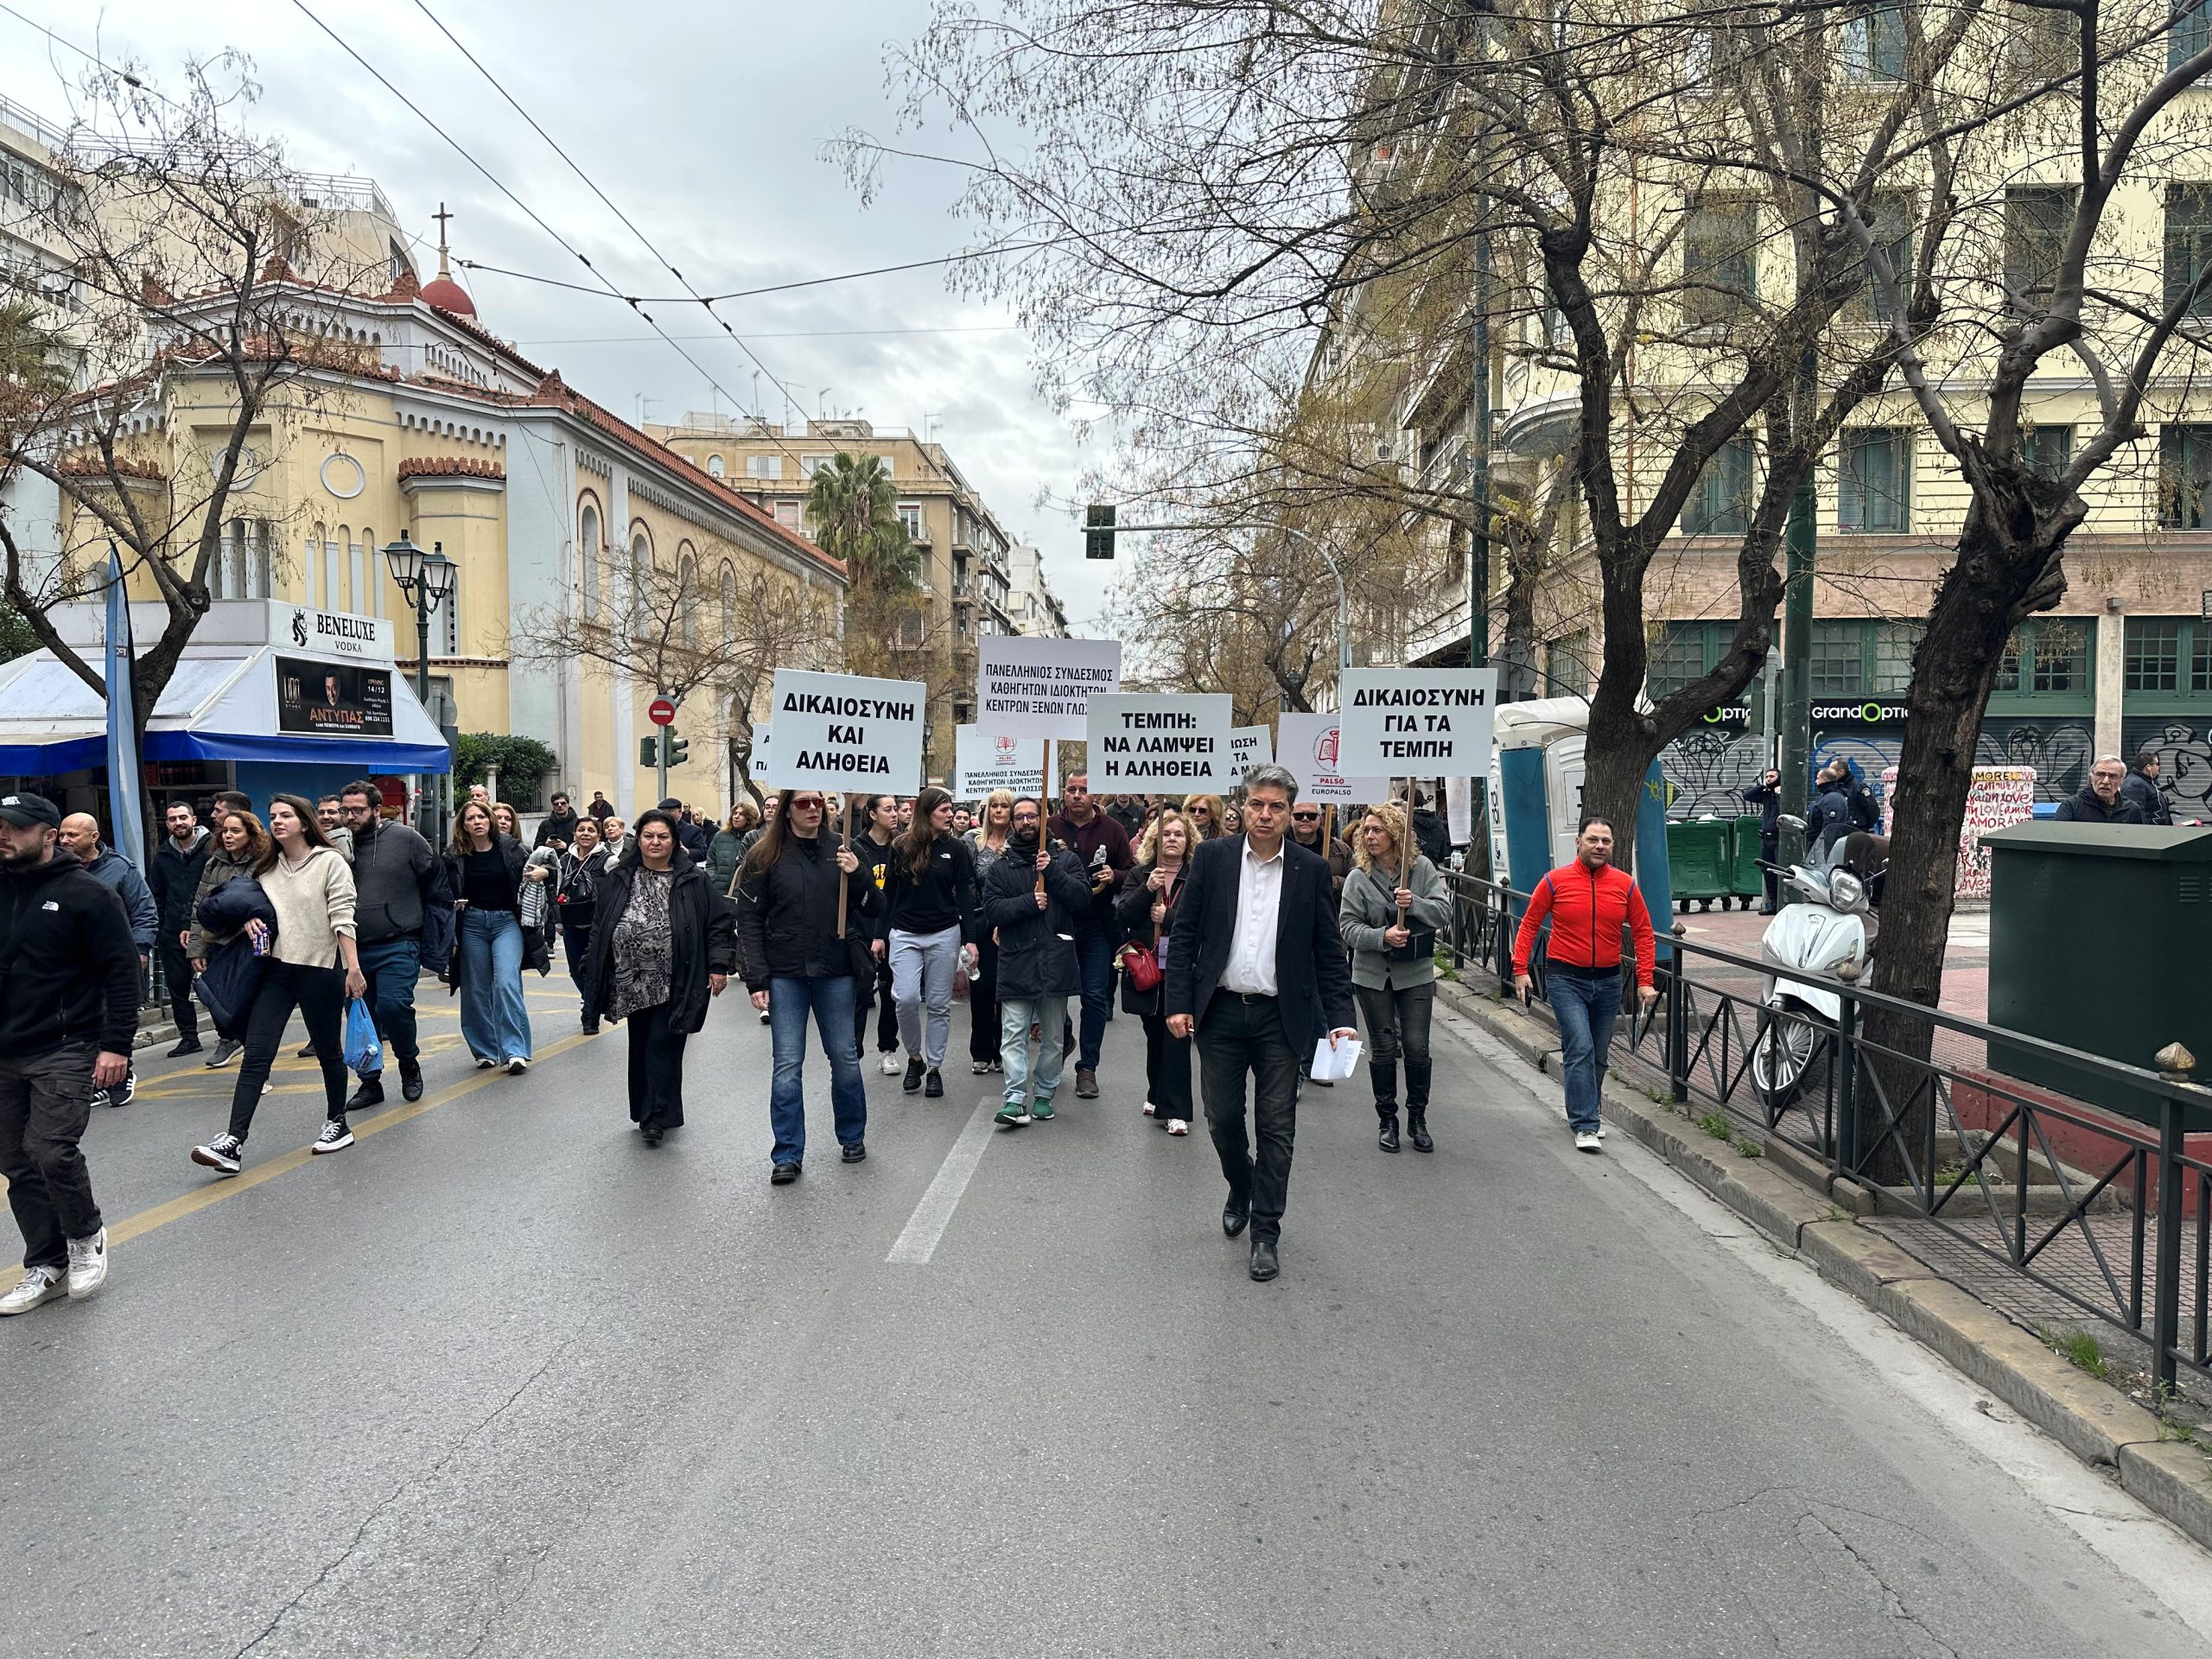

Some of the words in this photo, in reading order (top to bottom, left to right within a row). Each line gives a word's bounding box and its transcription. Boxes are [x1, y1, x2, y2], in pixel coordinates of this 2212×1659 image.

[316, 613, 376, 641] BENELUXE
[335, 640, 362, 652] VODKA
[986, 664, 1052, 679] ΠΑΝΕΛΛΗΝΙΟΣ
[1055, 666, 1113, 682] ΣΥΝΔΕΣΜΟΣ
[990, 682, 1047, 696] ΚΑΘΗΓΗΤΩΝ
[783, 692, 914, 721] ΔΙΚΑΙΟΣΥΝΗ
[1353, 689, 1485, 707] ΔΙΚΑΙΟΣΥΝΗ
[986, 699, 1029, 713] ΚΕΝΤΡΩΝ
[1032, 701, 1064, 715] ΞΕΝΩΝ
[1066, 702, 1087, 715] ΓΛΩ
[310, 707, 364, 725] ΑΝΤΥΠΑΣ
[1122, 713, 1197, 728] ΤΕΜΠΗ:
[1384, 715, 1418, 732] ΓΙΑ
[1424, 715, 1451, 732] ΤΑ
[828, 724, 863, 745] ΚΑΙ
[1230, 737, 1257, 749] ΙΩΣΗ
[1103, 737, 1130, 753] ΝΑ
[1136, 737, 1214, 753] ΛΑΜΨΕΙ
[1380, 741, 1452, 758] ΤΕΜΠΗ
[796, 750, 890, 774] ΑΛΗΘΕΙΑ
[1233, 752, 1249, 762] ΤΑ
[1106, 760, 1119, 776] Η
[1125, 760, 1212, 777] ΑΛΗΘΕΙΑ
